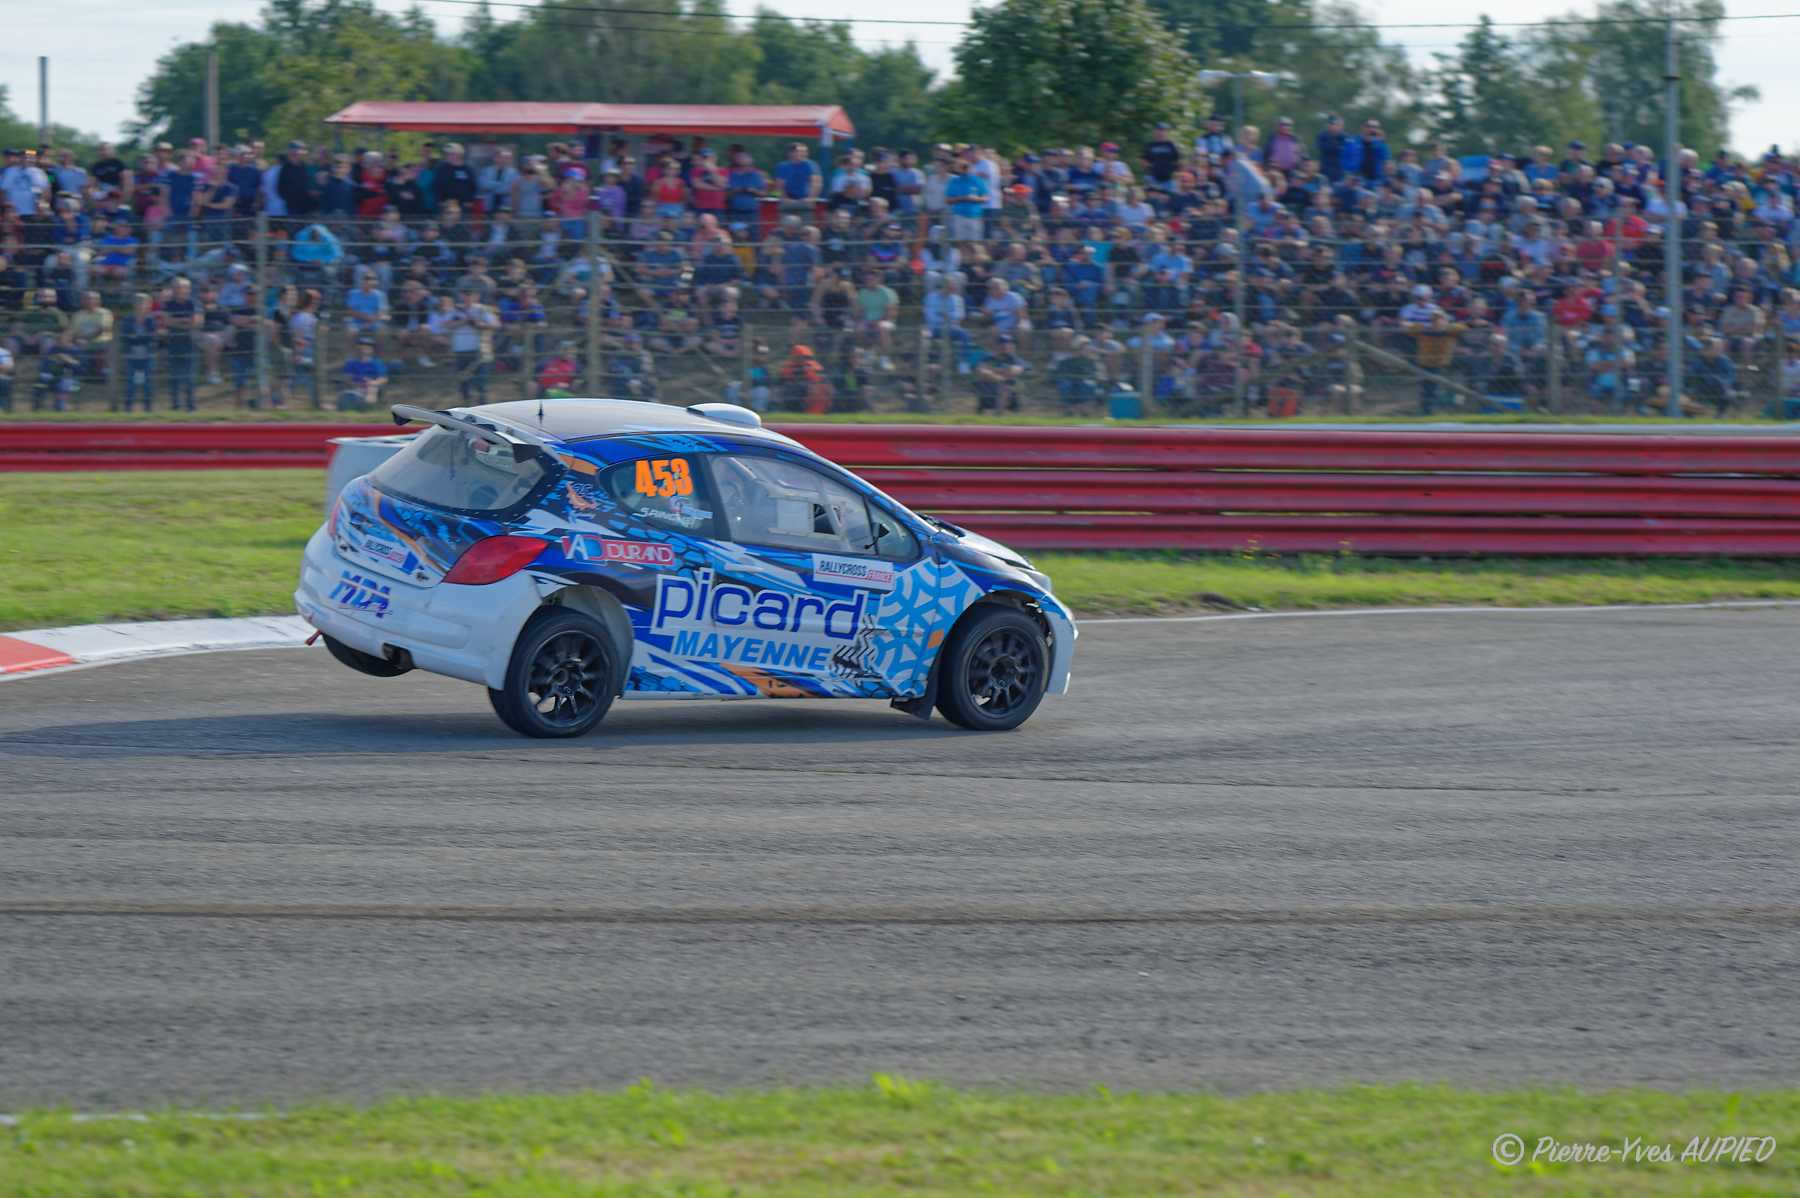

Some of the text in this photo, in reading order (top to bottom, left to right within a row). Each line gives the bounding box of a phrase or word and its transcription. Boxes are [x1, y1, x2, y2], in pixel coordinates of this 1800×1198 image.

[635, 458, 694, 497] 453
[819, 560, 867, 577] RALLYCROSS
[655, 571, 864, 641] picard
[673, 630, 832, 671] MAYENNE
